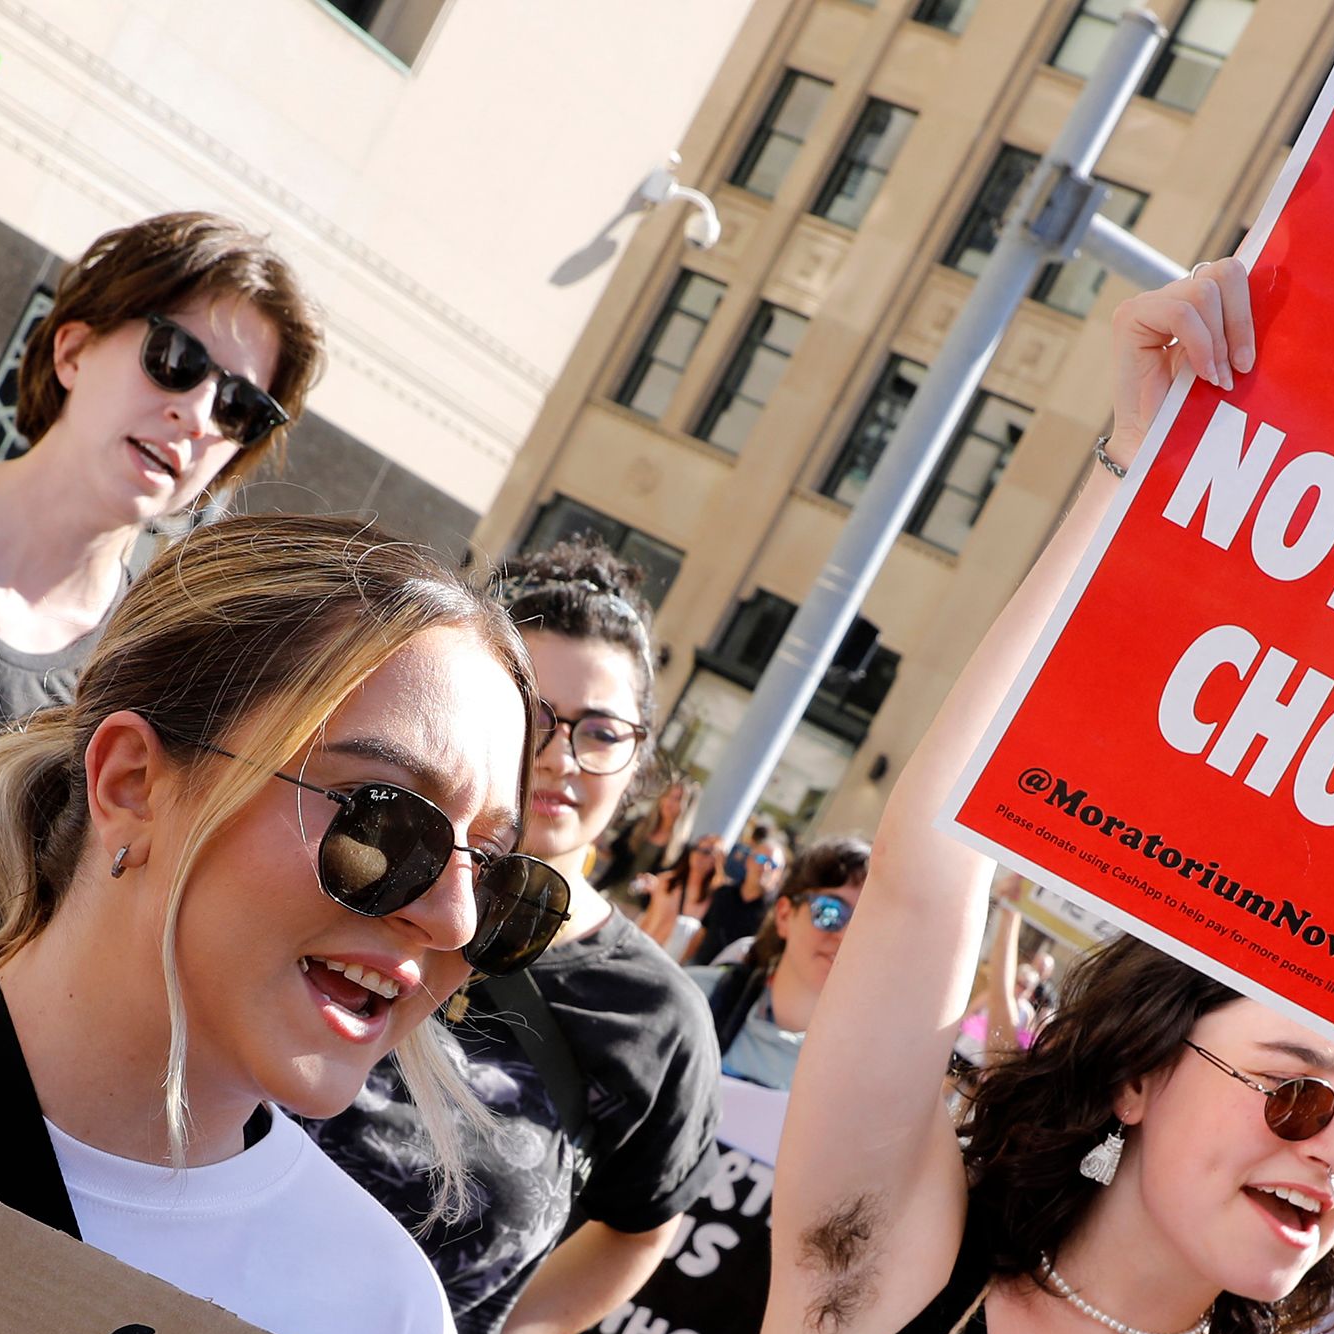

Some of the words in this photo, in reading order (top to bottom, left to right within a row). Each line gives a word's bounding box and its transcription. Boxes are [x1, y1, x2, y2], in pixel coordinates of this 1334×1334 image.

[995, 804, 1034, 831] Please
[1035, 826, 1077, 854] donate
[1078, 850, 1111, 874] using
[1112, 866, 1163, 900] CashApp
[1164, 895, 1178, 908] to
[1179, 901, 1206, 924] help
[1205, 919, 1229, 937] pay
[1229, 929, 1248, 946] for
[1248, 942, 1280, 963] more
[1279, 958, 1324, 988] posters
